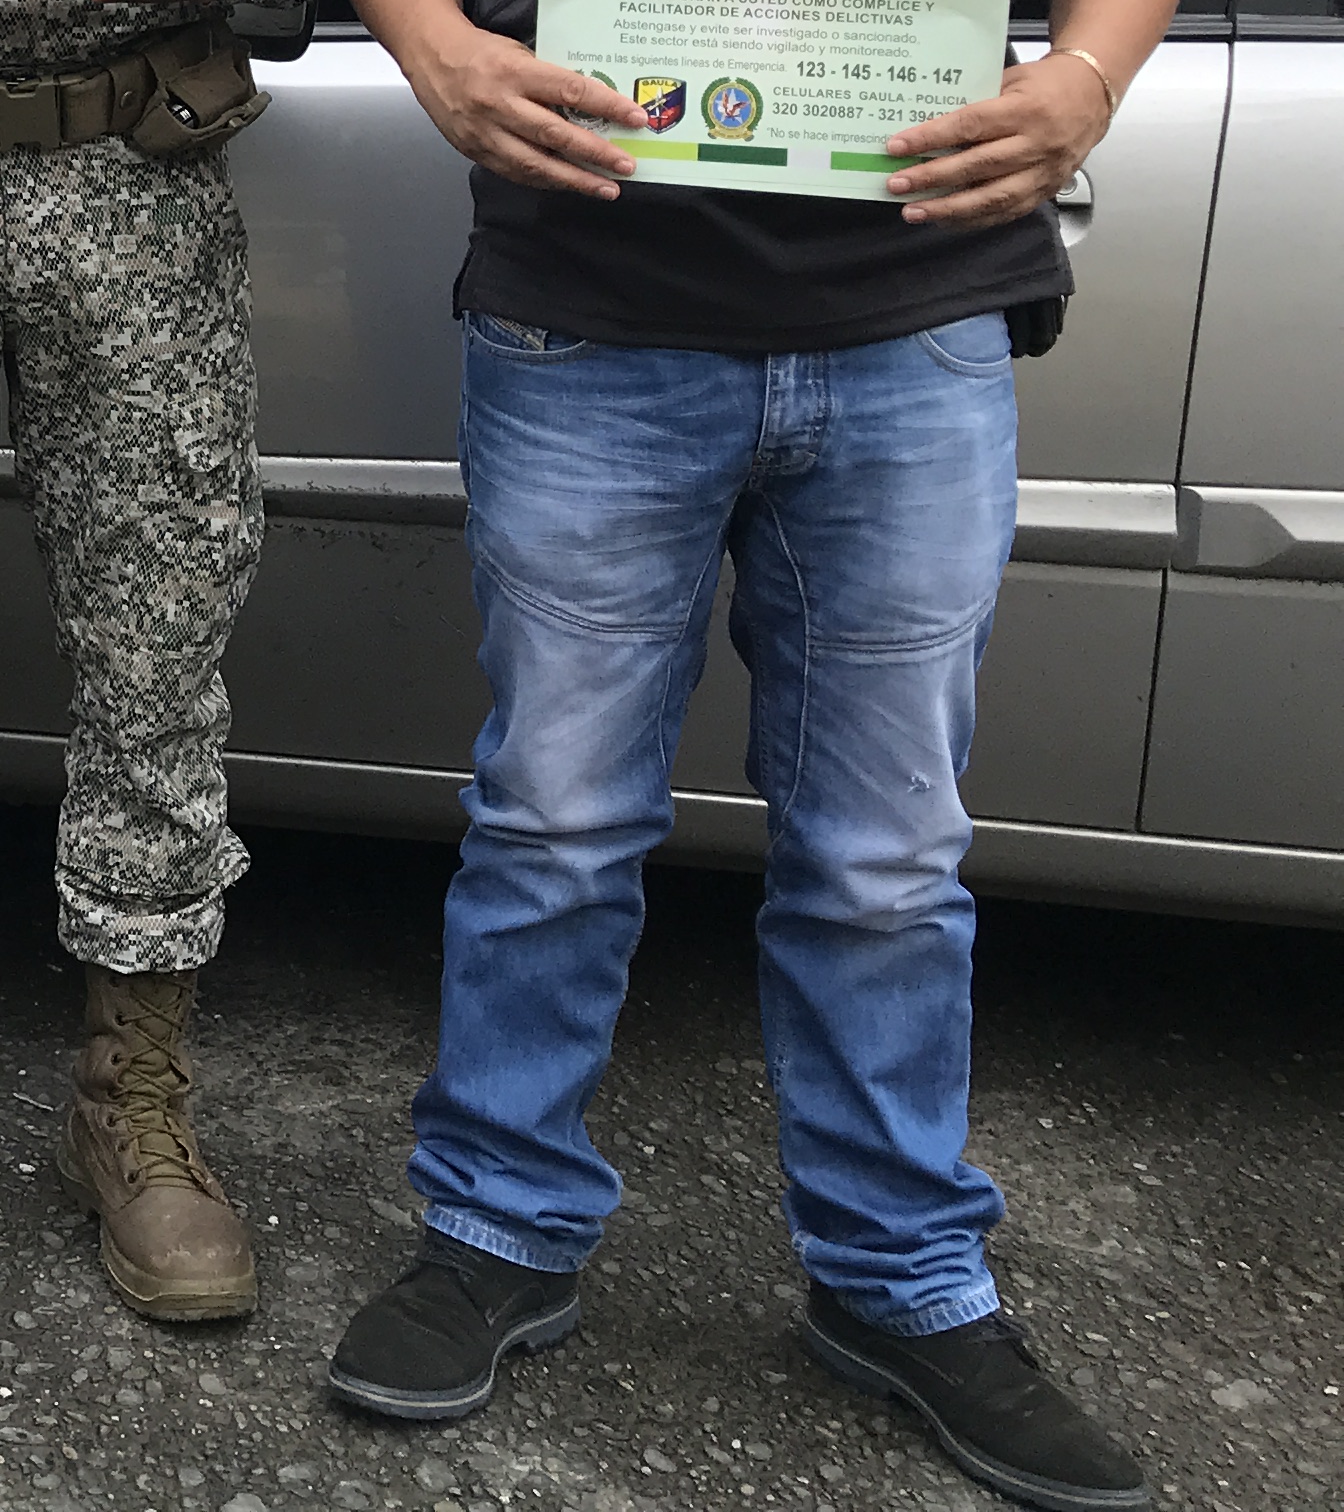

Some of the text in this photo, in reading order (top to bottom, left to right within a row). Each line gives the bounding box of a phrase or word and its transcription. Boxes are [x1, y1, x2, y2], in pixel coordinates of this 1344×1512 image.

[619, 2, 915, 27] FACILITADOR DE ACCIONES DELICTIVAS
[925, 2, 936, 14] Y
[796, 61, 964, 85] 123 145 146 147
